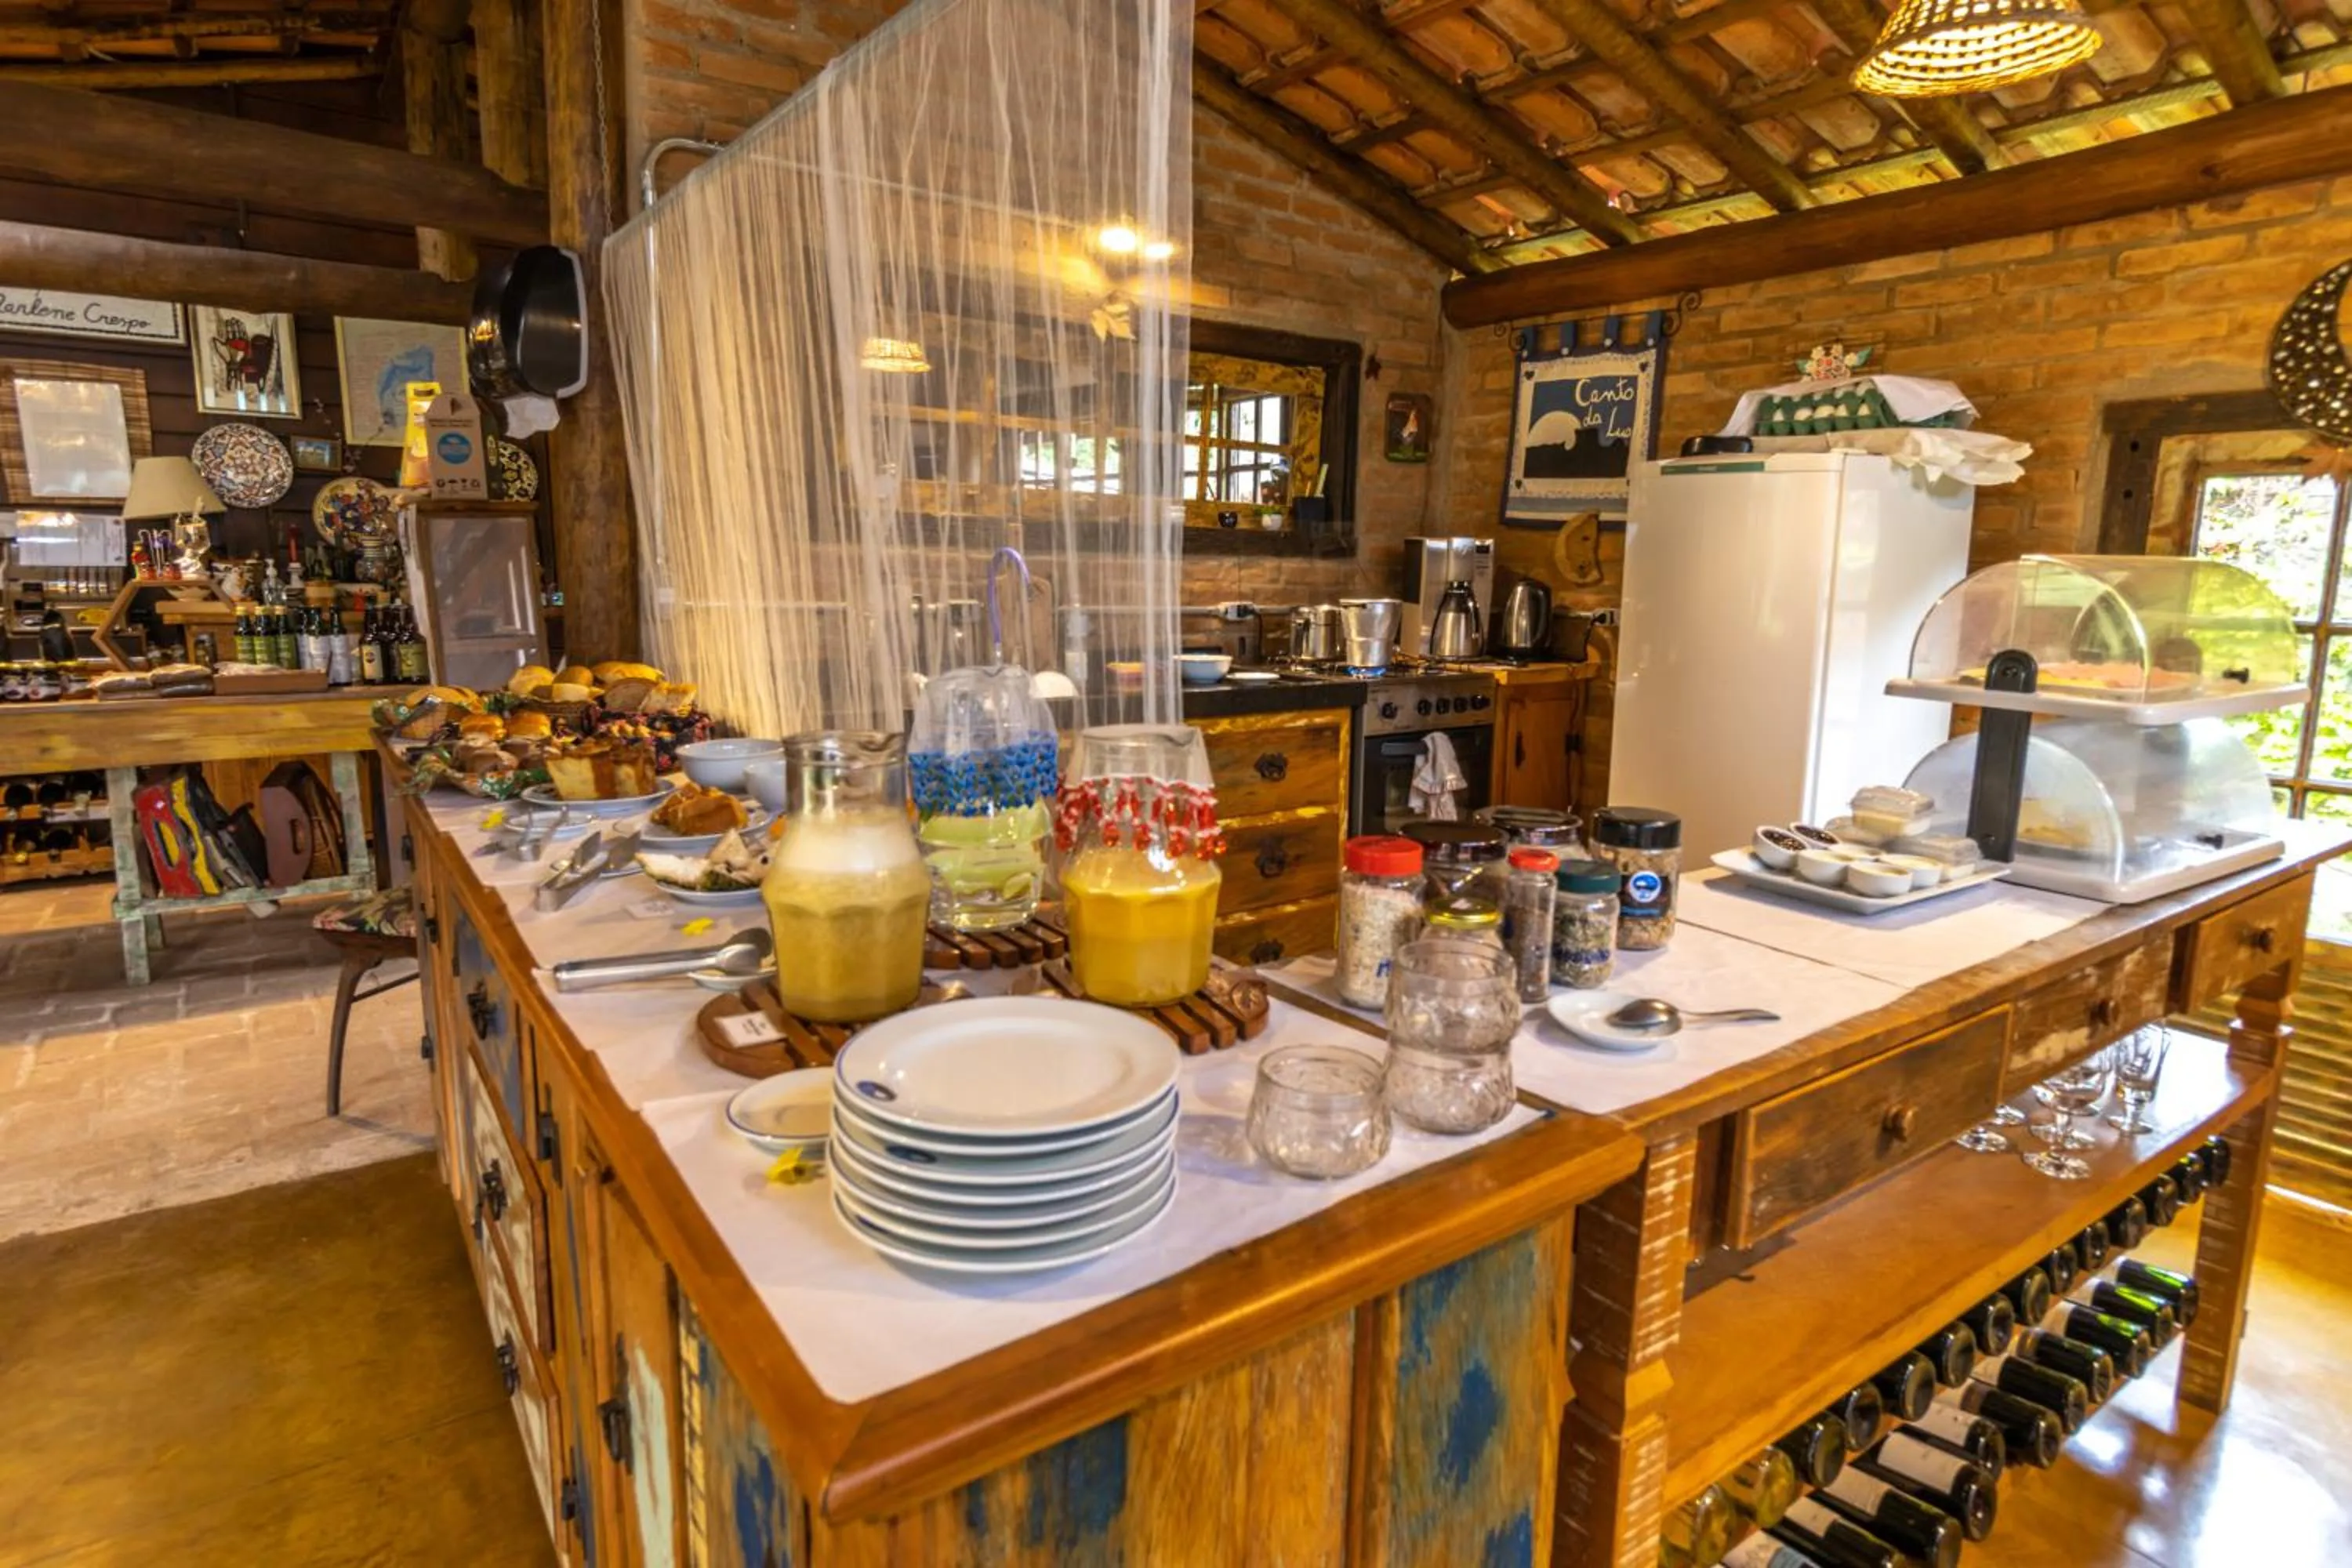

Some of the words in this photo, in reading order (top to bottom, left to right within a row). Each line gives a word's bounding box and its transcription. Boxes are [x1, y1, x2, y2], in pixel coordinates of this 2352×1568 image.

[83, 302, 151, 335] Crespo
[1575, 376, 1635, 407] Canto
[1583, 405, 1602, 427] da
[1605, 406, 1632, 438] Lua
